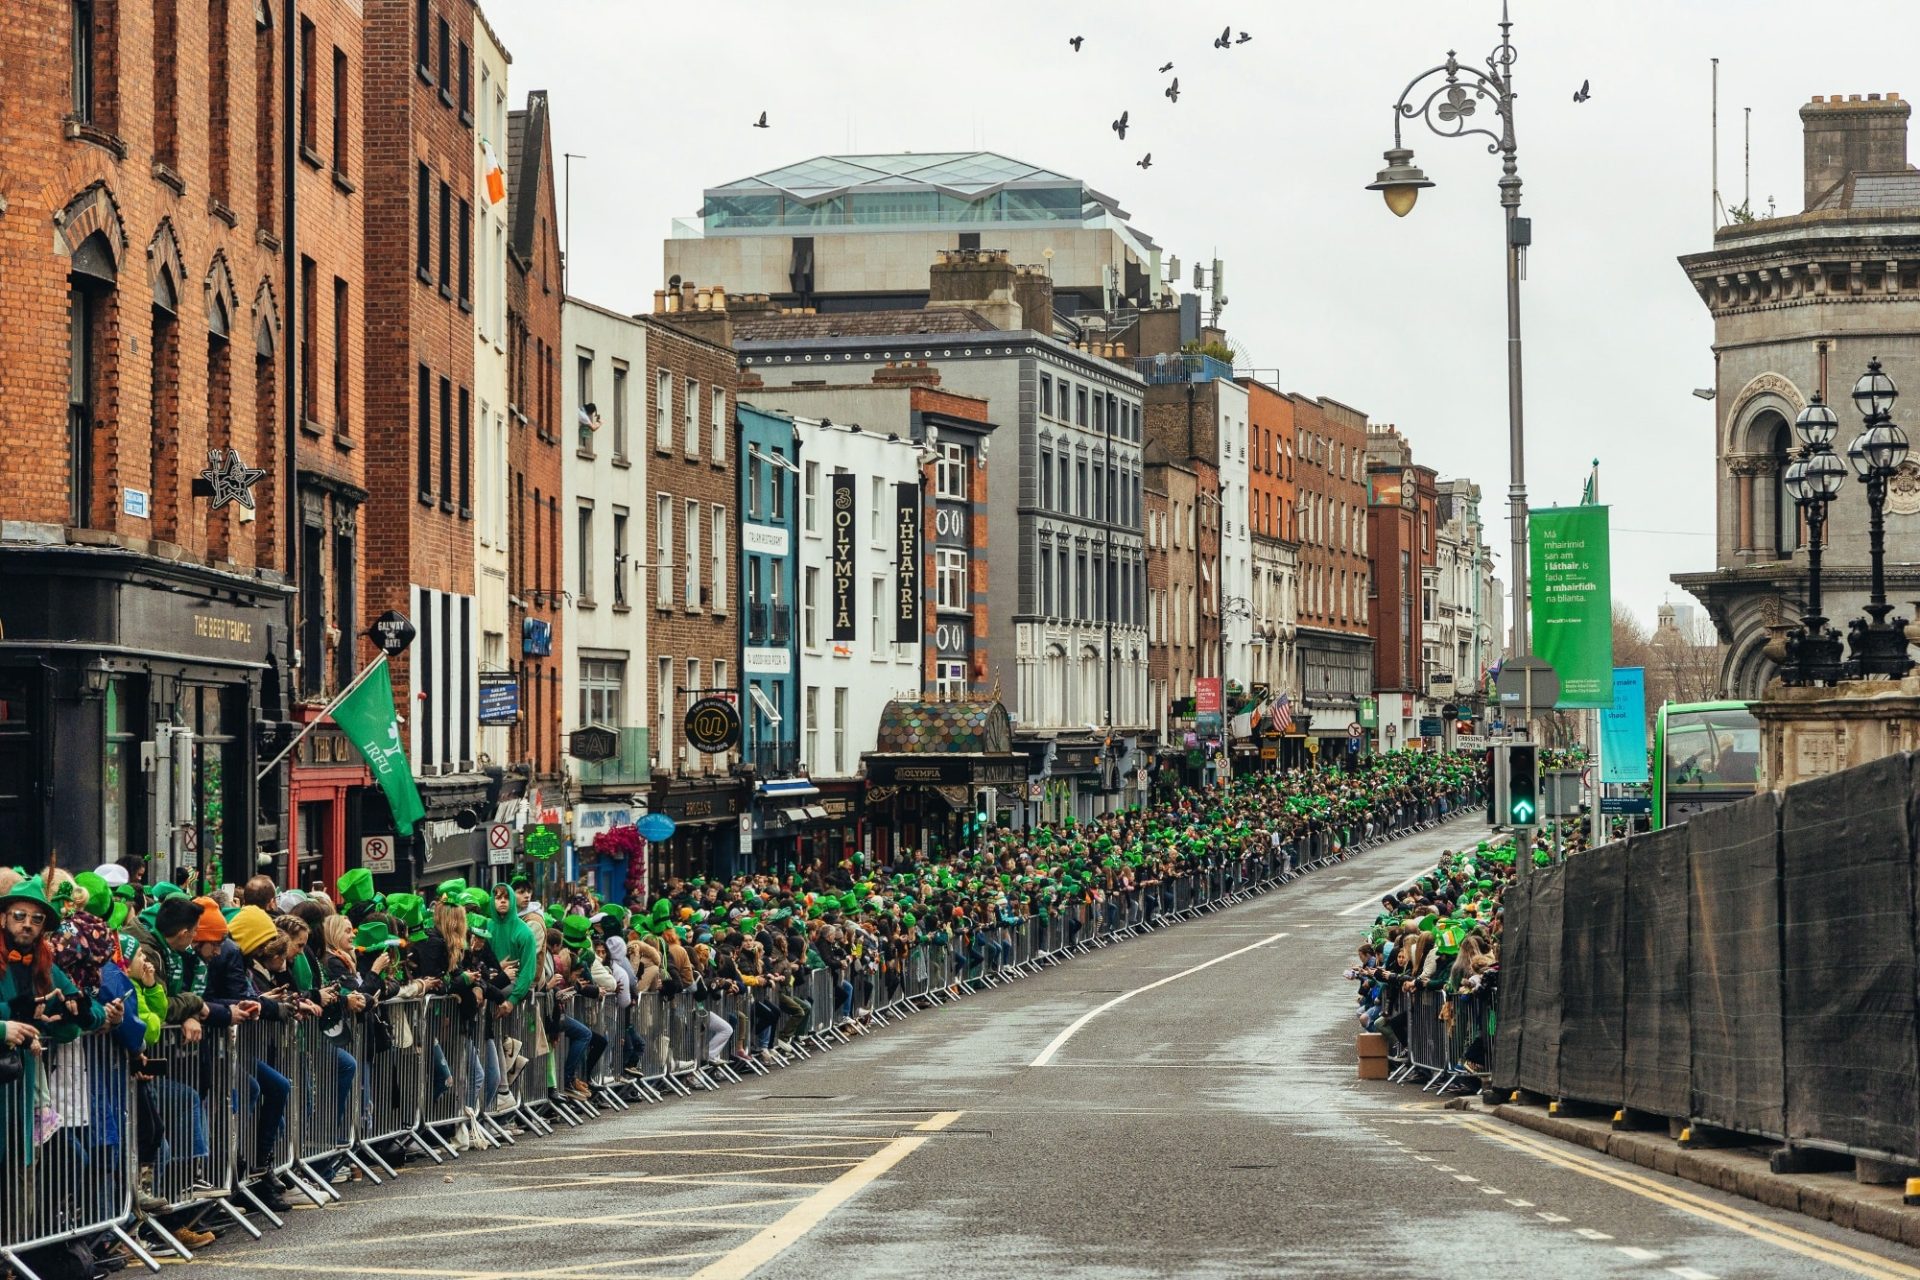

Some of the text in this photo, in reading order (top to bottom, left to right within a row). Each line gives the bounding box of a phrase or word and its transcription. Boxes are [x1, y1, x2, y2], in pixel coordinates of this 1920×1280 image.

[1544, 530, 1557, 539] Má
[1544, 540, 1585, 549] mhairimid
[900, 508, 914, 619] THEATRE
[1544, 562, 1548, 570] i
[1582, 562, 1589, 570] is
[835, 511, 852, 628] OLYMPIA
[1545, 573, 1563, 581] fada
[1552, 582, 1597, 592] mhairfidh
[194, 614, 251, 643] THE BEER TEMPLE
[377, 621, 405, 631] GALWAY
[1351, 738, 1358, 746] P
[1458, 735, 1483, 743] CROSSING
[576, 733, 611, 756] EAT
[363, 740, 393, 775] IRFU
[904, 769, 942, 778] OLYMPIA
